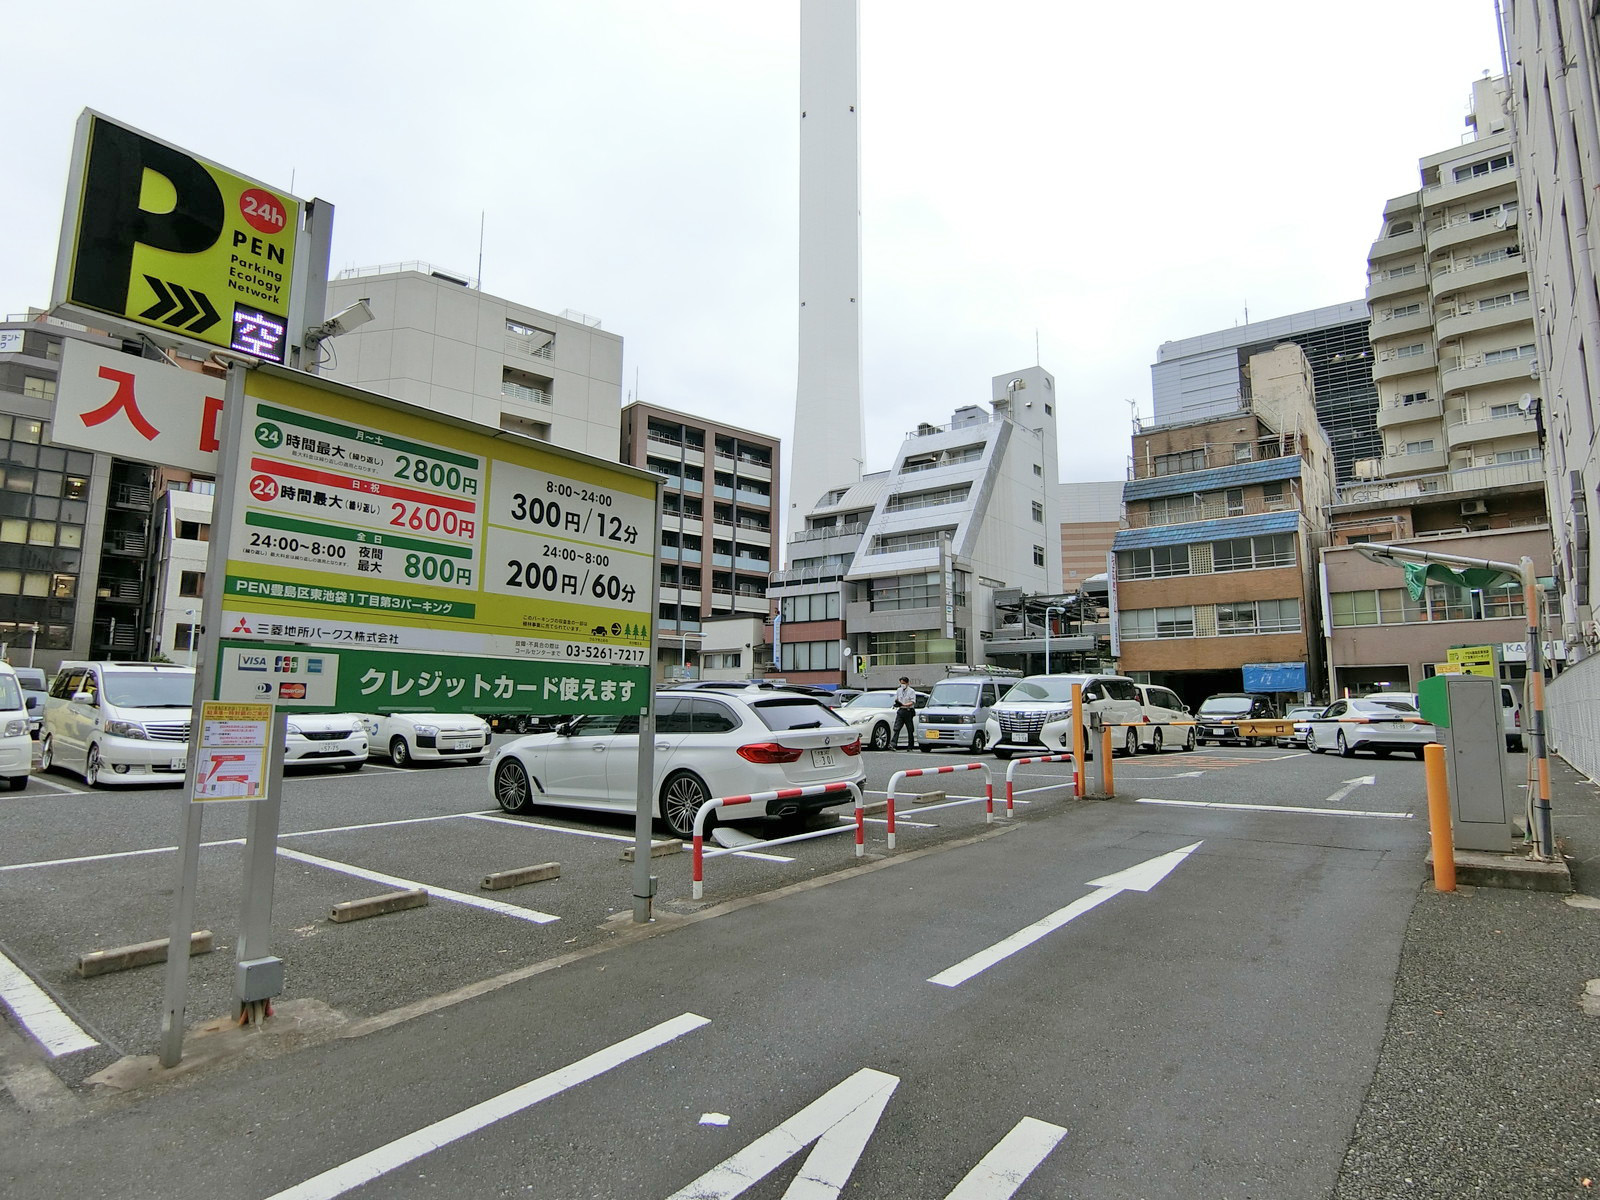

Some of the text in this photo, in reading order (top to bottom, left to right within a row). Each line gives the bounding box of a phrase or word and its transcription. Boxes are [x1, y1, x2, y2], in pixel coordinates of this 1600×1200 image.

[72, 118, 225, 315] P
[243, 196, 285, 227] 24h
[233, 230, 285, 265] PEN
[229, 267, 281, 294] Ecology
[230, 254, 283, 282] Parking
[228, 279, 280, 304] Network
[232, 312, 284, 362] 空
[286, 433, 346, 460] 時間最大
[394, 455, 478, 495] 2800円
[352, 480, 380, 494] 日・祝
[280, 485, 343, 510] 時間最大
[390, 502, 475, 539] 2600円
[359, 546, 383, 561] 夜間
[358, 554, 472, 587] 最大 800円
[257, 623, 399, 644] 三菱地所パークス株式会社
[242, 656, 266, 665] VISA
[566, 644, 644, 662] 03-5261-7217
[360, 668, 636, 702] クレジットカード使えます
